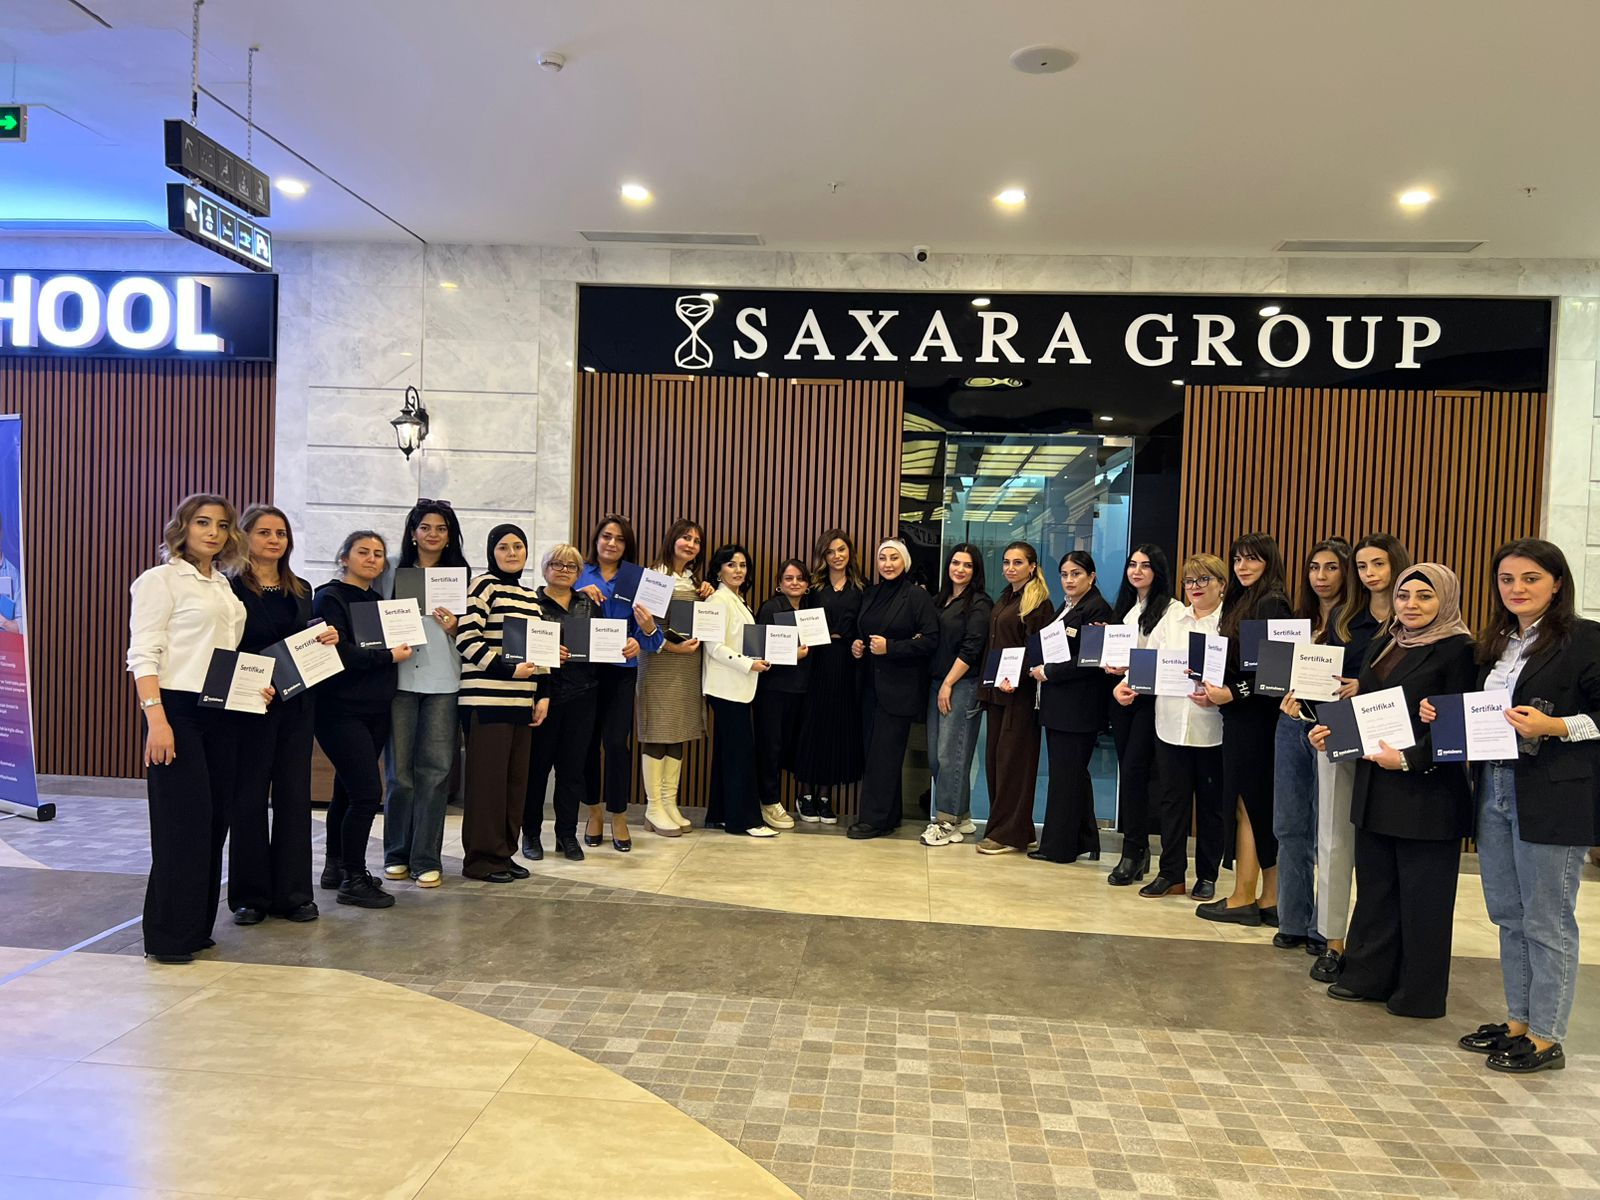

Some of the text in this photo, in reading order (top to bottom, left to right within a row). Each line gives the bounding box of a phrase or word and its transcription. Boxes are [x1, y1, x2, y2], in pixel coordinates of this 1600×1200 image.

[733, 307, 1442, 369] SAXARA GROUP
[385, 608, 411, 616] Sertifikat
[531, 628, 554, 636] Sertifikat
[1300, 654, 1333, 664] Sertifikat
[240, 664, 265, 675] Sertifikat
[1361, 701, 1395, 715] Sertifikat
[1471, 704, 1503, 713] Sertifikat
